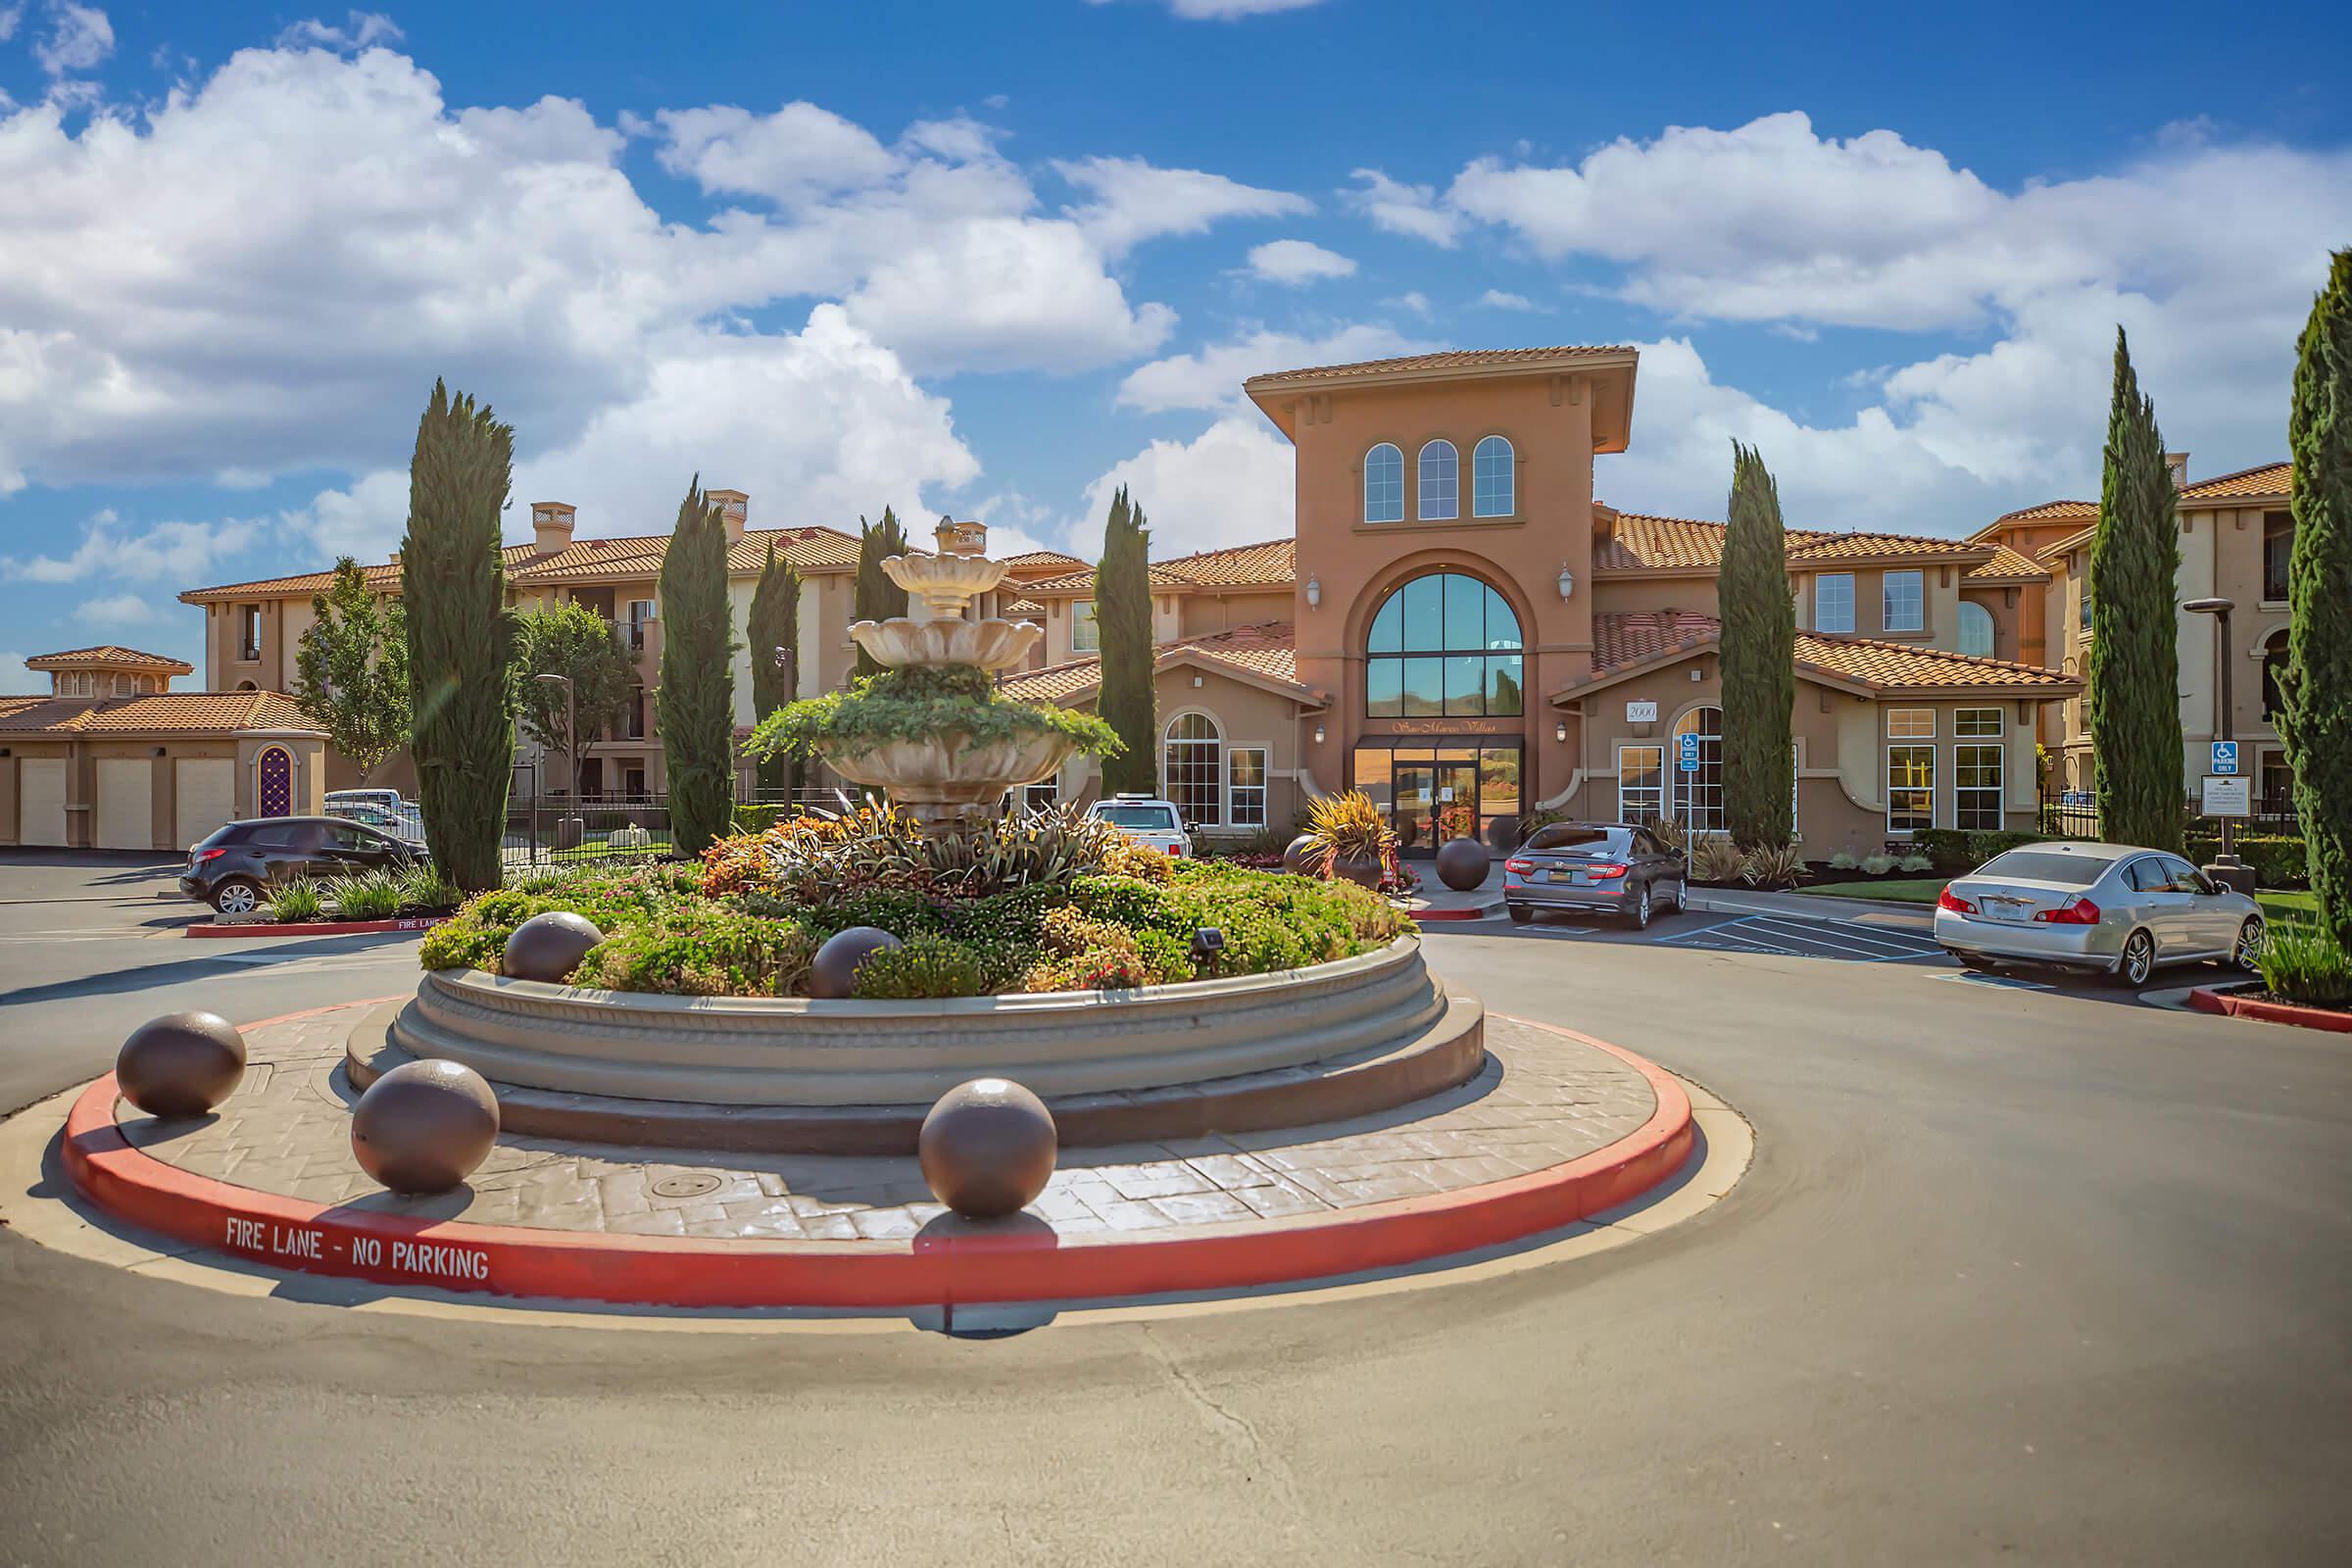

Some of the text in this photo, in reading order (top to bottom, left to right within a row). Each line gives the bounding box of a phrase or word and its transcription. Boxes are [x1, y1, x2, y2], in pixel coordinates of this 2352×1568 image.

[1629, 706, 1655, 718] 2000
[399, 920, 416, 930] FIRE
[226, 1217, 266, 1250] FIRE
[272, 1225, 323, 1259] LANE
[352, 1237, 382, 1267] NO
[392, 1242, 489, 1280] PARKING
